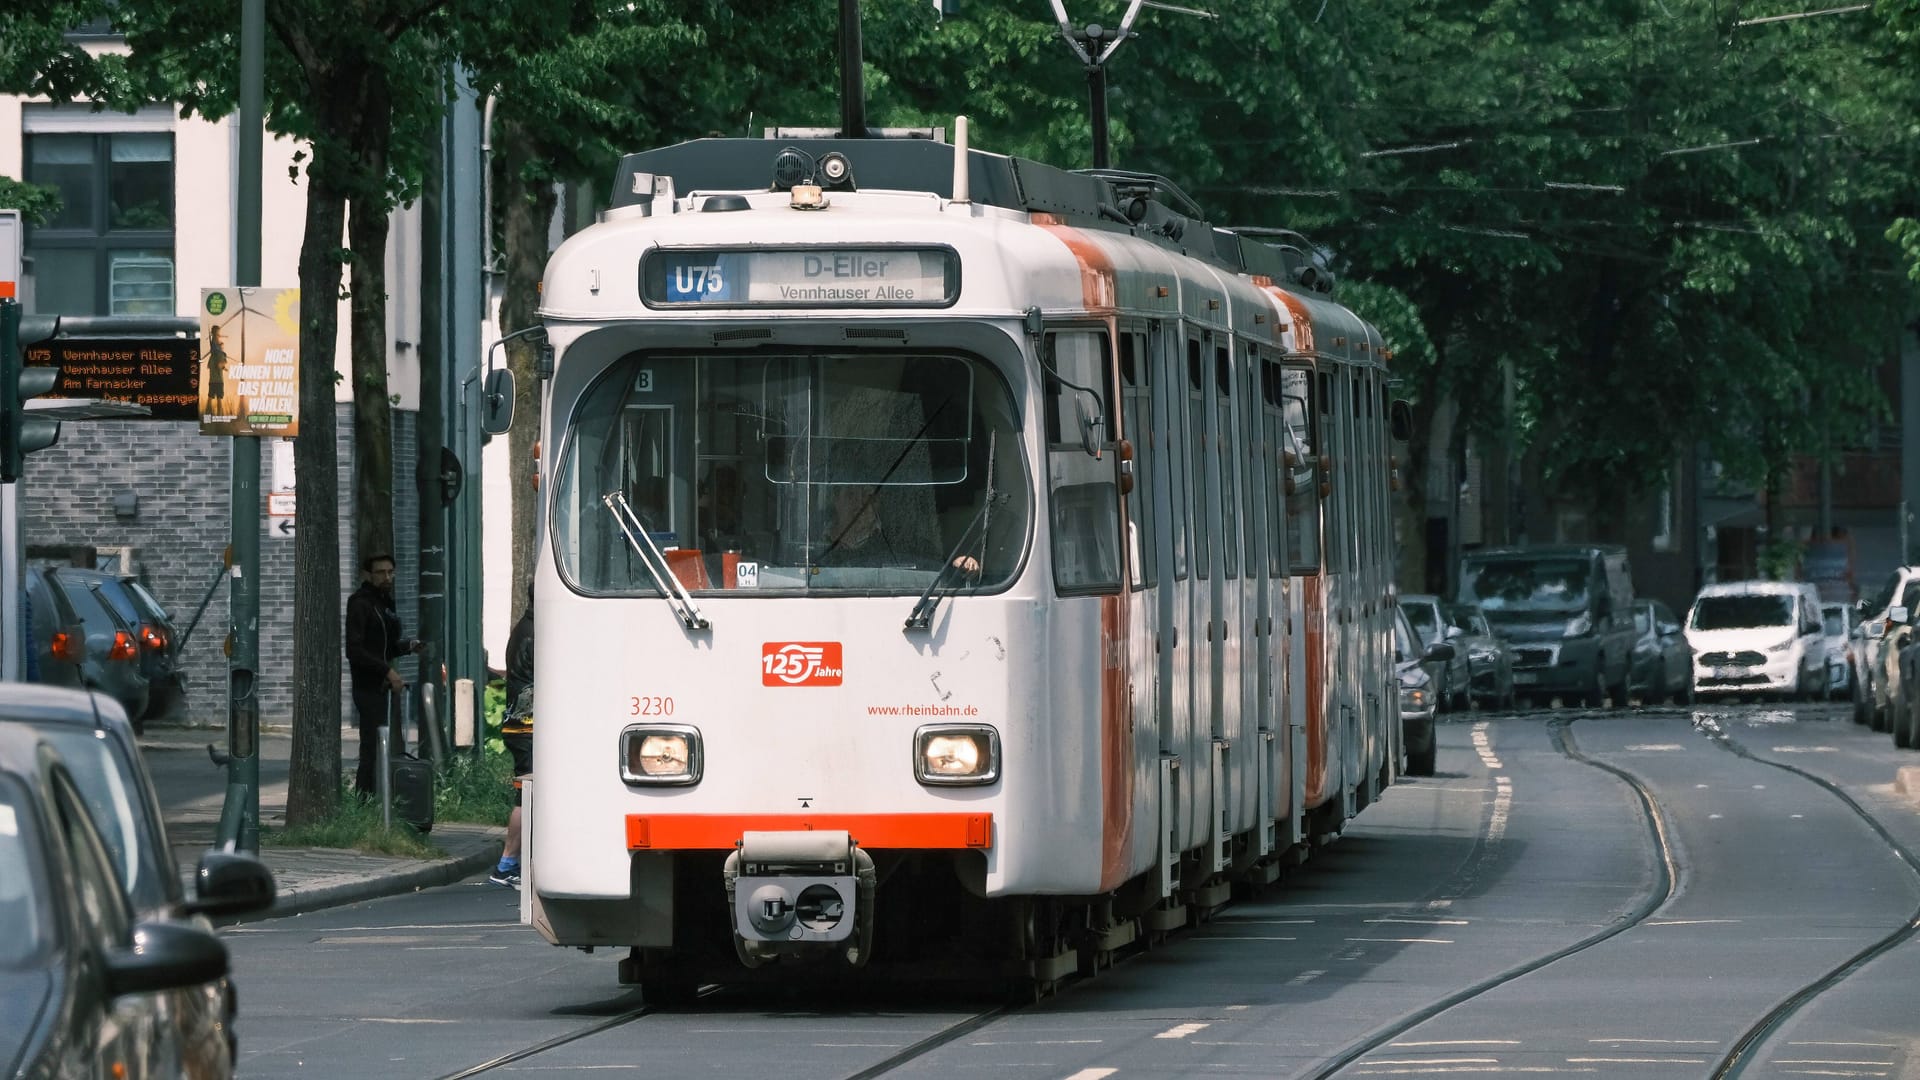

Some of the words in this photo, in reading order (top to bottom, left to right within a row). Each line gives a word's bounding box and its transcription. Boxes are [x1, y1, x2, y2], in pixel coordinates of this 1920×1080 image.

[675, 265, 724, 294] U75
[803, 255, 889, 278] D-Eller
[779, 285, 870, 300] Vennhauser
[875, 285, 914, 300] Allee
[140, 350, 173, 361] Allee
[190, 350, 198, 361] 2
[264, 349, 294, 364] NOCH
[140, 364, 173, 375] Allee
[228, 362, 271, 379] KÖNNEN
[273, 365, 294, 379] WIR
[63, 378, 82, 389] Am
[639, 372, 649, 388] B
[237, 381, 260, 395] DAS
[260, 381, 294, 395] KLIMA
[738, 564, 756, 577] 04
[762, 653, 803, 676] 125
[814, 665, 842, 678] Jahre
[631, 696, 674, 716] 3230
[867, 704, 978, 717] www.rheinbahn.de
